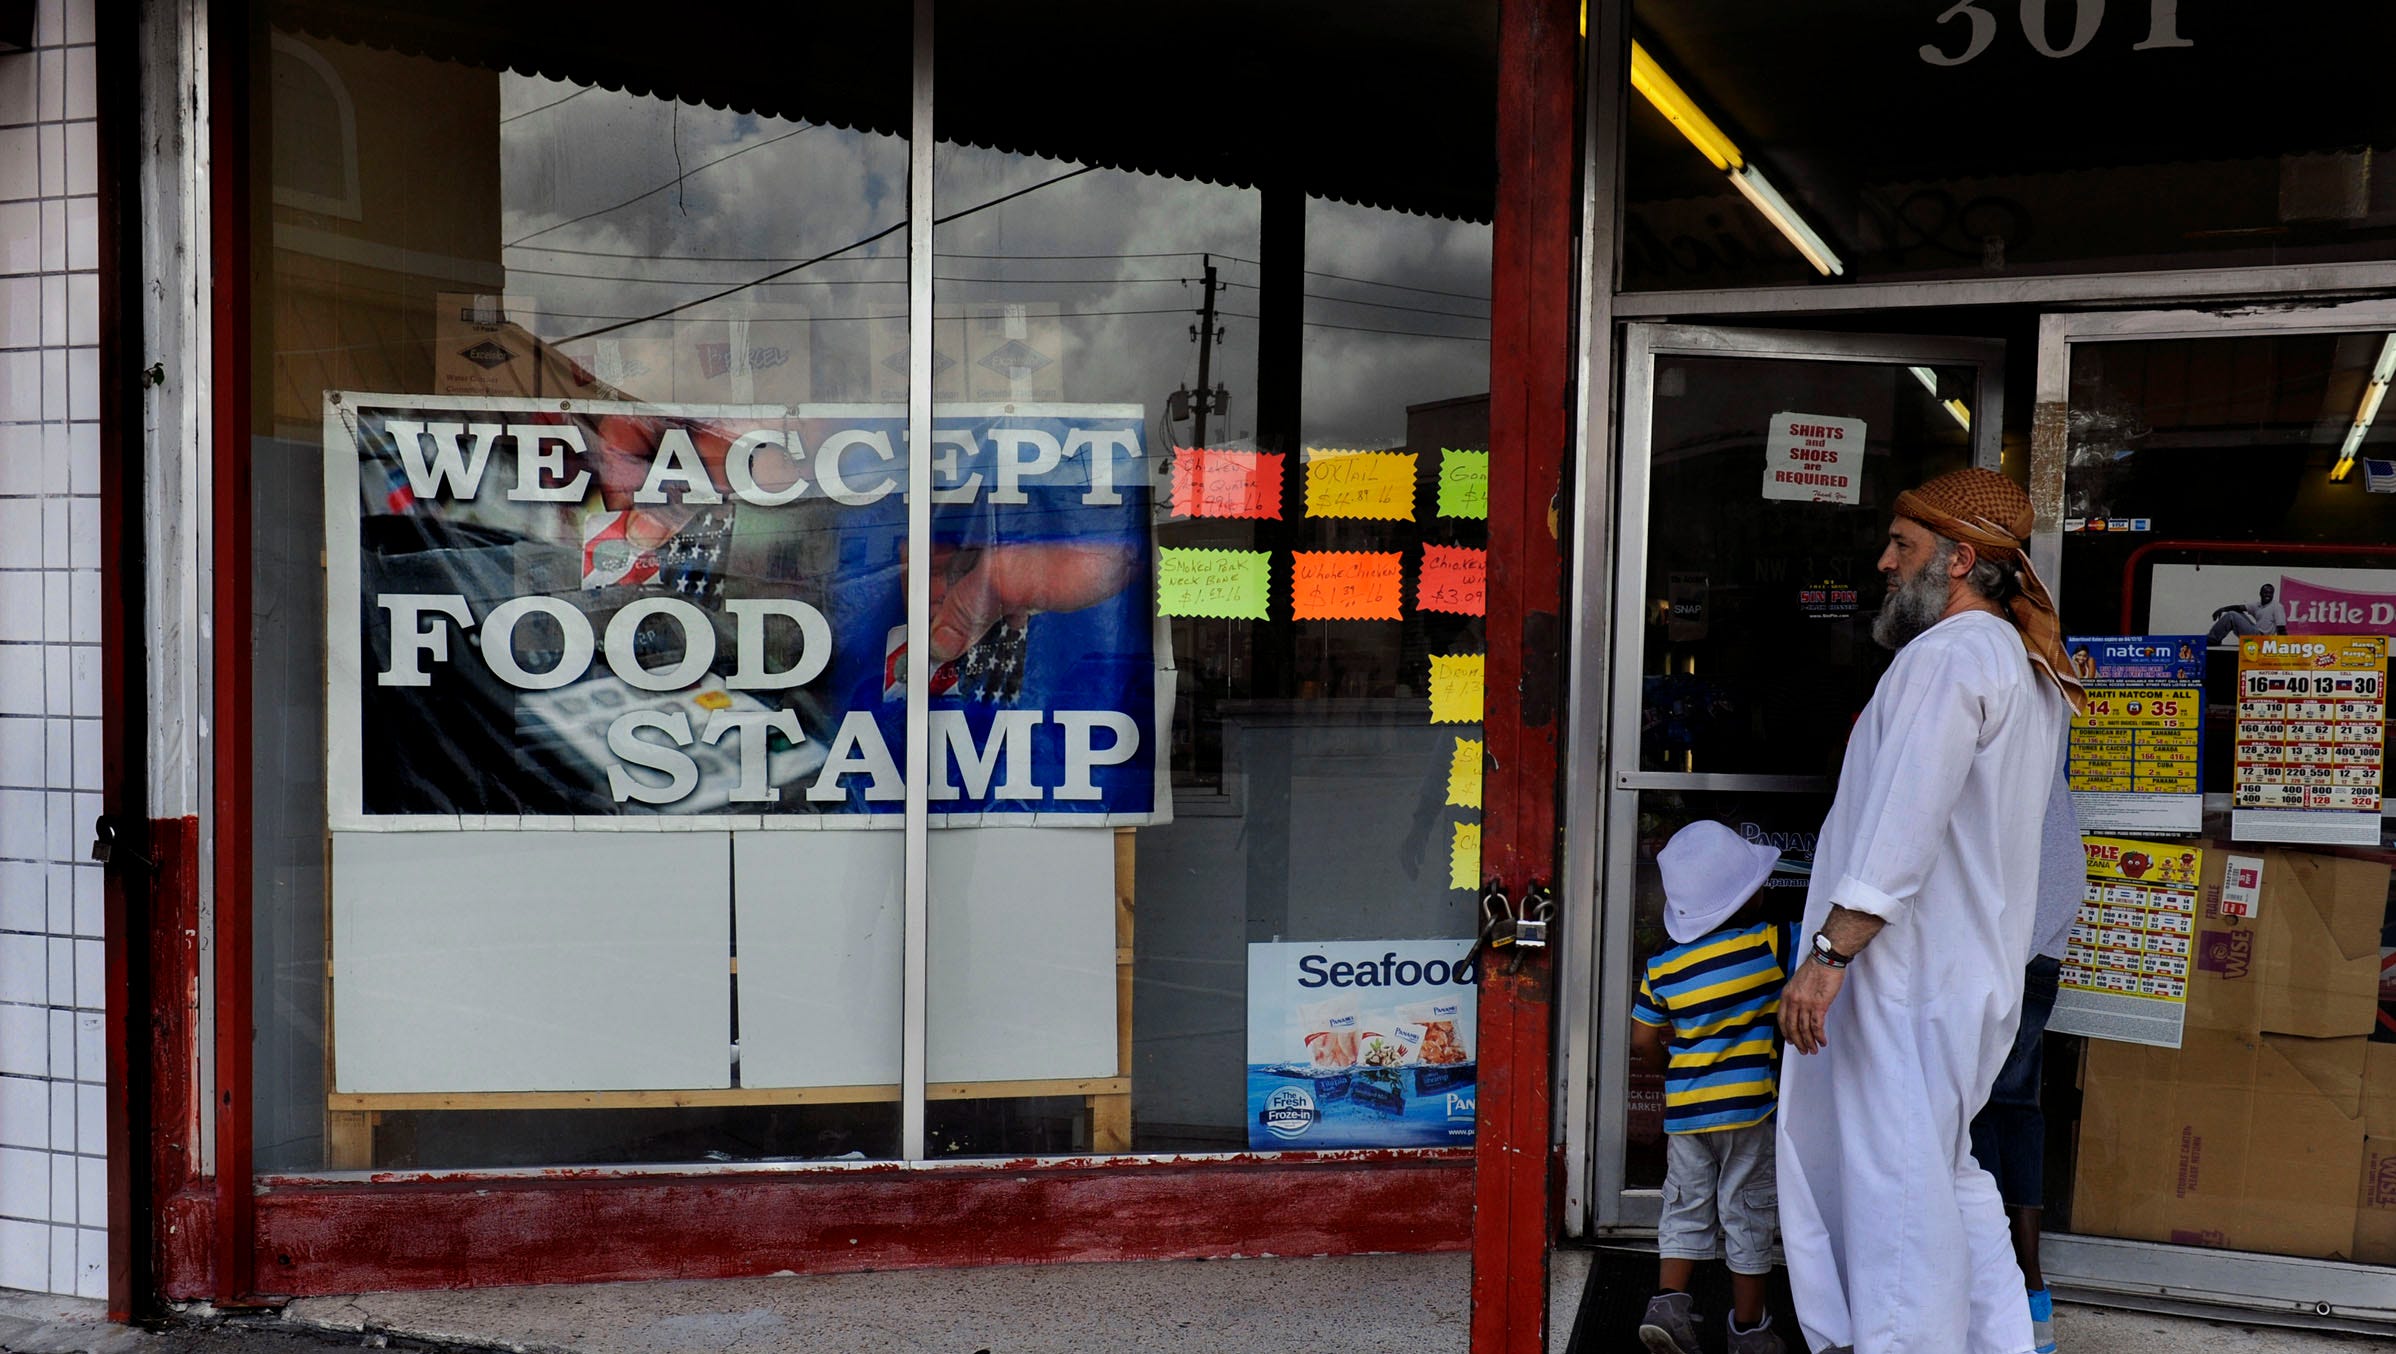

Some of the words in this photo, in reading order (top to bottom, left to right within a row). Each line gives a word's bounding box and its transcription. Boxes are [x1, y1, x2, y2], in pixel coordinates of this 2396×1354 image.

[1790, 424, 1844, 439] SHIRTS
[1805, 439, 1825, 447] and
[384, 419, 593, 503] WE
[633, 425, 1142, 508] ACCEPT
[1790, 448, 1838, 463] SHOES
[1804, 463, 1821, 471] are
[1776, 471, 1848, 487] REQUIRED
[1813, 490, 1832, 498] Thank
[1835, 492, 1847, 500] You
[1800, 591, 1825, 603] SIN
[1831, 591, 1857, 603] PIN
[1674, 604, 1701, 614] SNAP
[2287, 600, 2363, 624] Little
[2369, 602, 2396, 624] D
[377, 593, 833, 691] FOOD
[2262, 640, 2326, 658] Mango
[2107, 645, 2170, 656] natcom
[2248, 677, 2267, 692] 16
[2287, 678, 2308, 693] 40
[2314, 678, 2333, 693] 13
[2355, 678, 2376, 693] 30
[2087, 701, 2109, 715] 14
[2151, 701, 2178, 716] 35
[607, 707, 1141, 804] STAMP
[2310, 769, 2330, 777] 550
[2206, 884, 2220, 919] FRAGILE
[2223, 928, 2253, 979] WISE
[1297, 952, 1477, 988] Seafood
[1274, 1097, 1306, 1107] Fresh
[1269, 1110, 1310, 1120] Froze-in
[2182, 1125, 2192, 1153] CARTON
[2192, 1136, 2202, 1163] RETURN
[2176, 1155, 2190, 1199] RETURNABLE
[2188, 1163, 2198, 1191] PLEASE
